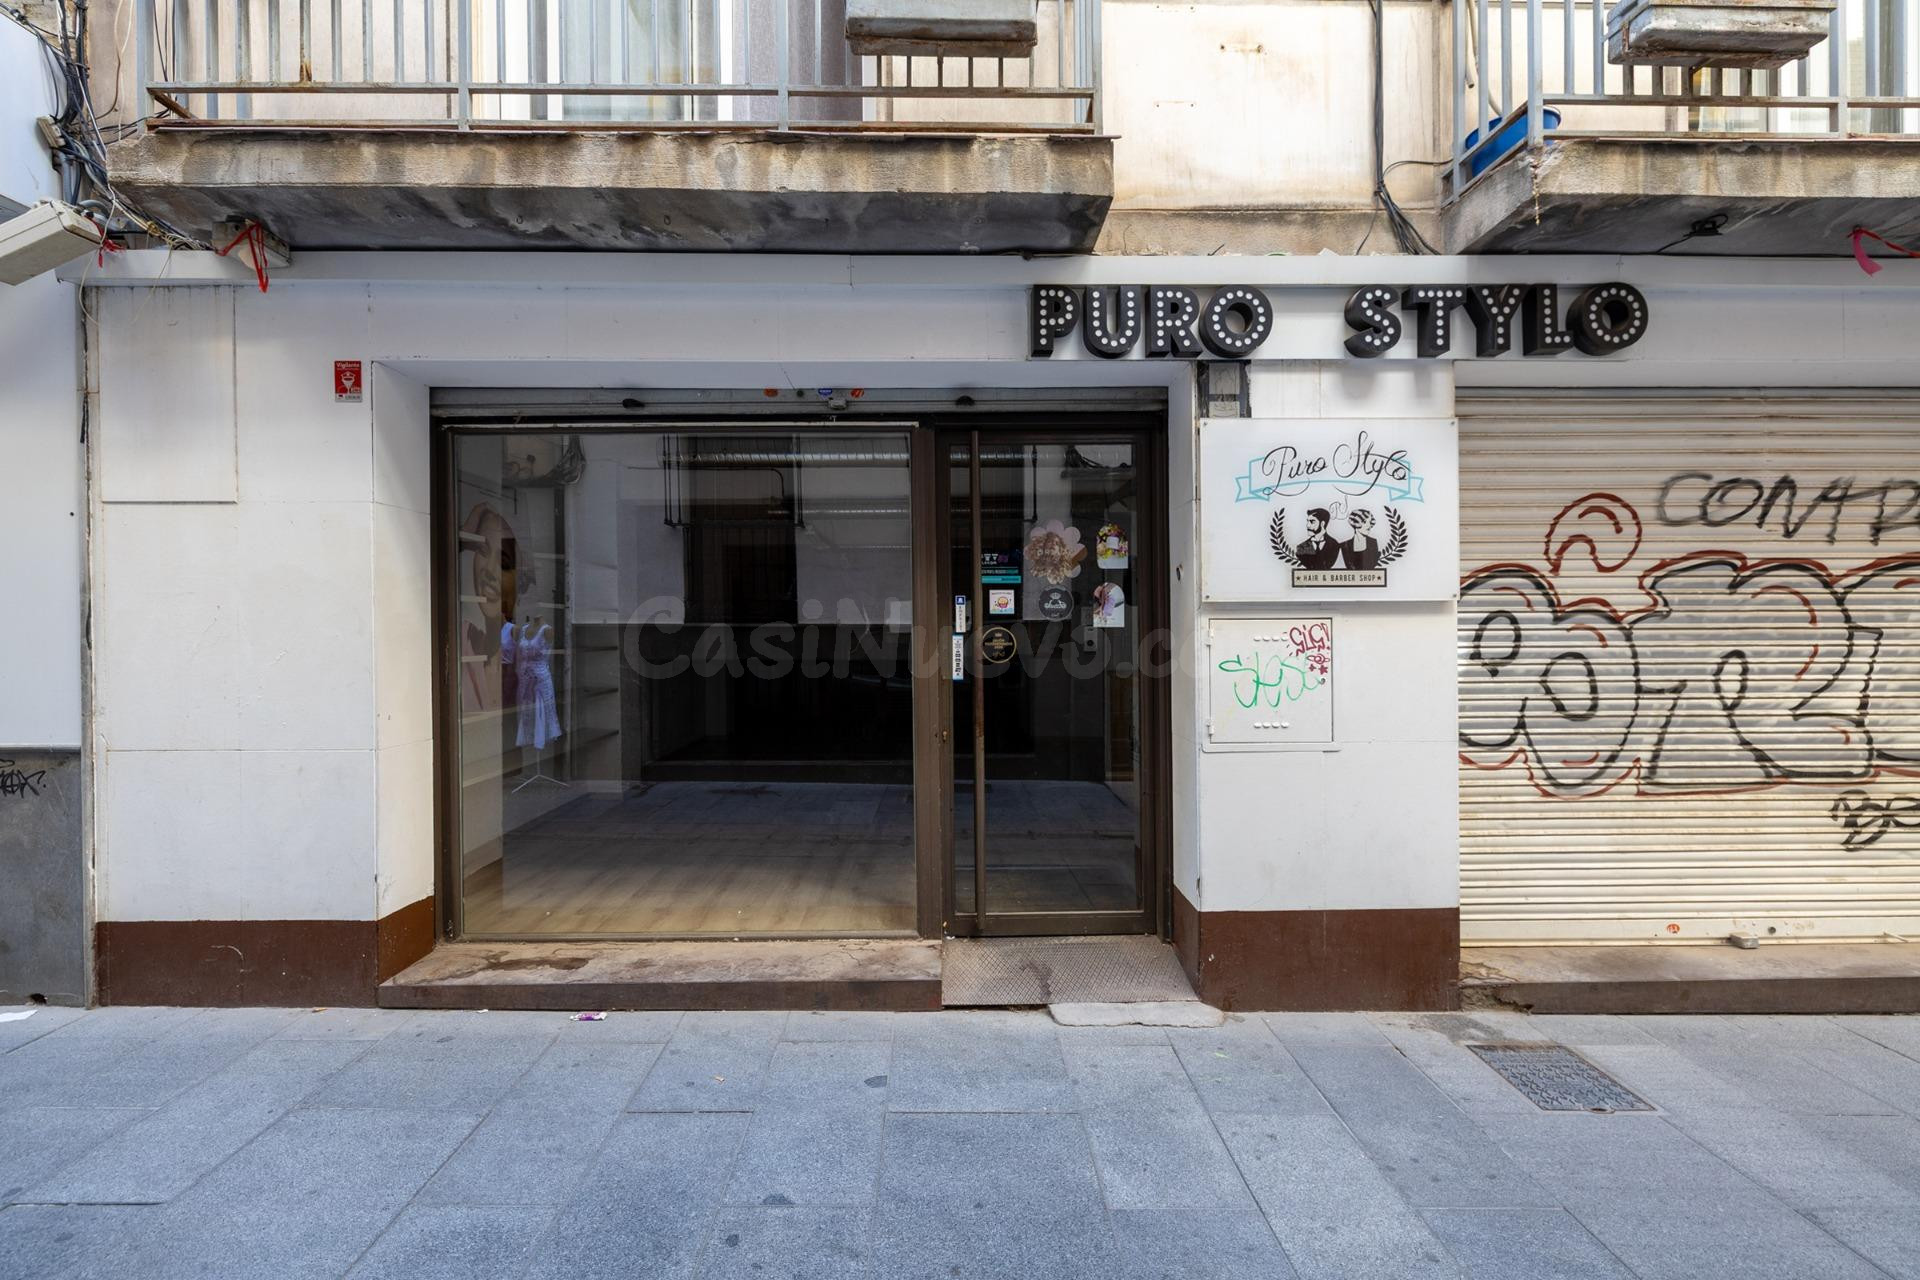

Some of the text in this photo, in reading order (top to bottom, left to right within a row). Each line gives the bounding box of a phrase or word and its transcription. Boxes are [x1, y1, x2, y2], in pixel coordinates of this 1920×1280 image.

[1031, 282, 1649, 358] PURO STYLO
[1262, 430, 1412, 497] Puro Stylo
[1303, 574, 1376, 582] HAIR & BARBER SHOP
